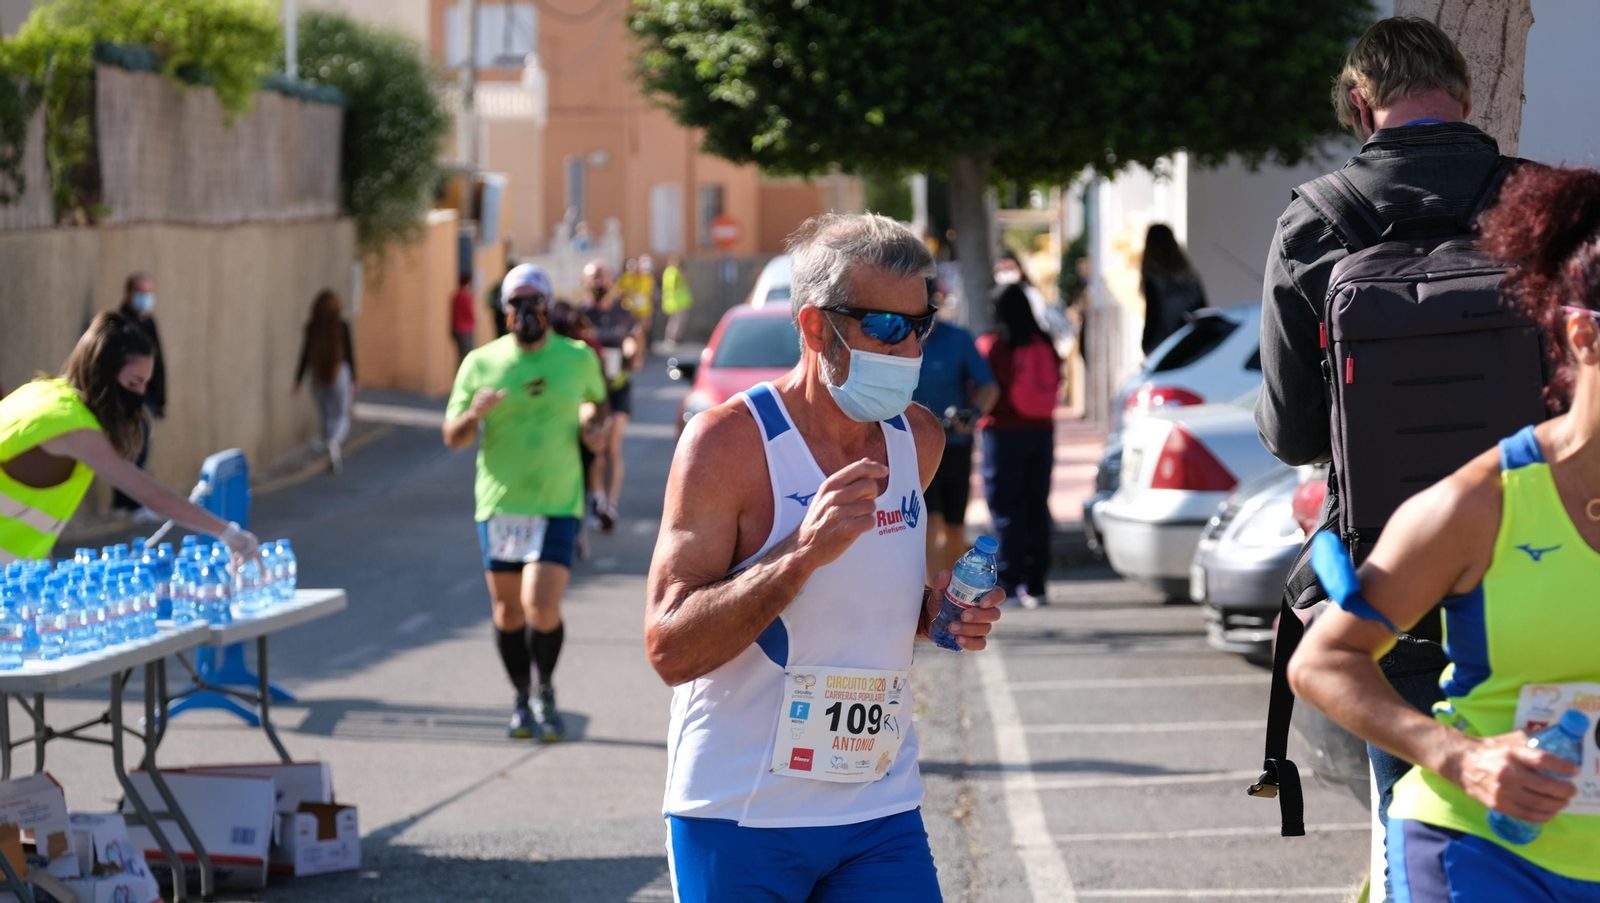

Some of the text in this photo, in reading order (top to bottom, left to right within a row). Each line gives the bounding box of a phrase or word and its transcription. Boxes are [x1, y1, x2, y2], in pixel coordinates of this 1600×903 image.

[877, 510, 916, 527] Run 04
[878, 525, 906, 535] atletismo
[826, 675, 866, 690] CIRCUITO
[825, 690, 857, 701] CARRERAS
[858, 692, 885, 702] POPULARES
[796, 704, 803, 716] F
[825, 701, 883, 735] 109
[832, 736, 875, 752] ANTONIO
